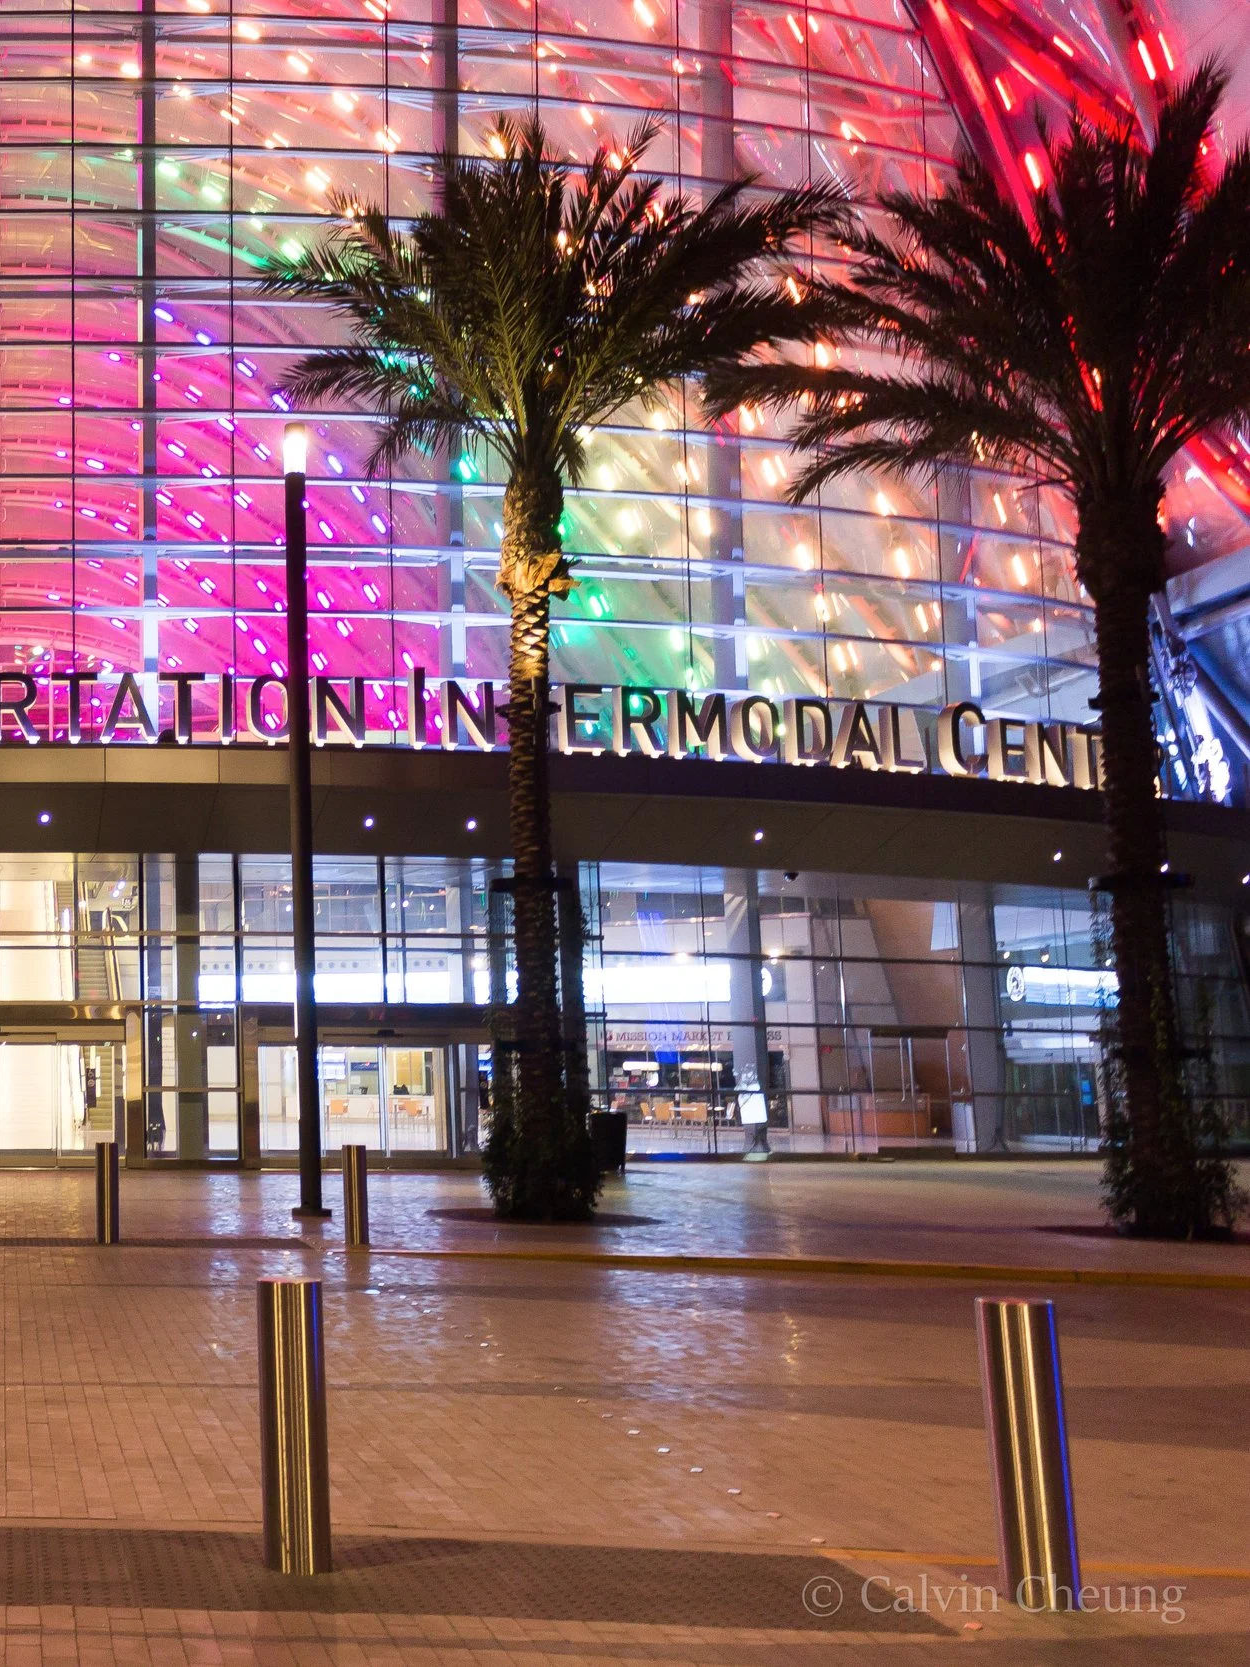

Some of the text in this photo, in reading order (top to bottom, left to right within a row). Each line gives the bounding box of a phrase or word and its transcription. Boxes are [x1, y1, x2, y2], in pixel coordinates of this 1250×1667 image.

[407, 666, 926, 774] INERMODAL
[938, 701, 1161, 799] CENT
[616, 1030, 667, 1042] MISSION
[671, 1030, 724, 1042] MARKET
